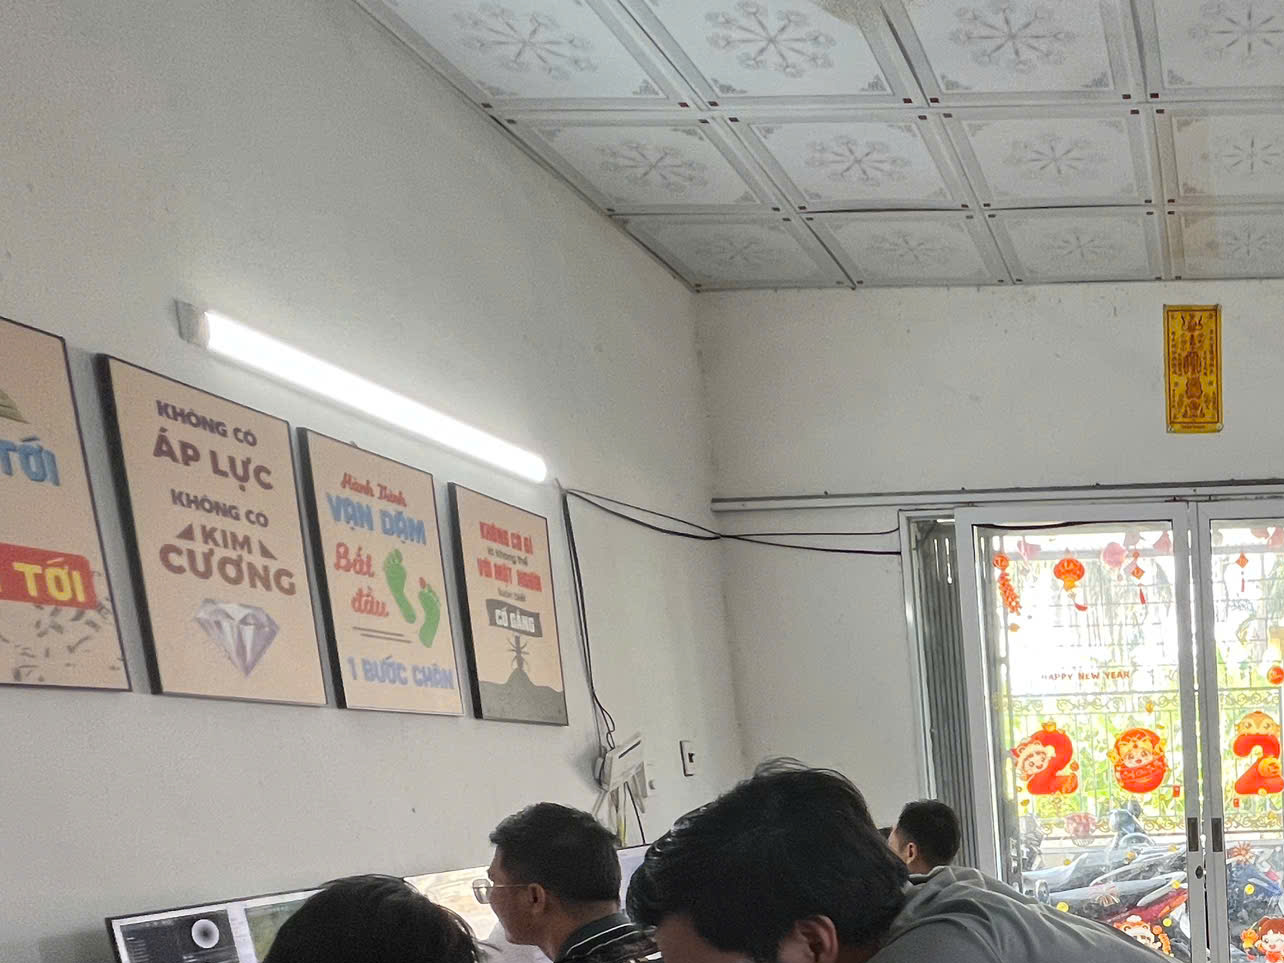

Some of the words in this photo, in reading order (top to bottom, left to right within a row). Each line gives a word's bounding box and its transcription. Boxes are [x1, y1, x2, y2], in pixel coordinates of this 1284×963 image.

[156, 400, 228, 438] KHÔNG
[153, 426, 200, 466] ÁP
[209, 449, 273, 492] LỰC
[170, 488, 240, 521] KHÔNG
[326, 492, 374, 531] VẠN
[200, 524, 253, 554] KIM
[12, 557, 86, 602] TỚI
[159, 543, 296, 596] CƯƠNG
[347, 656, 357, 680] 1
[361, 655, 409, 686] BƯỚC
[412, 662, 455, 689] CHÂN
[1078, 672, 1100, 680] NEW
[1104, 671, 1130, 680] YEAR
